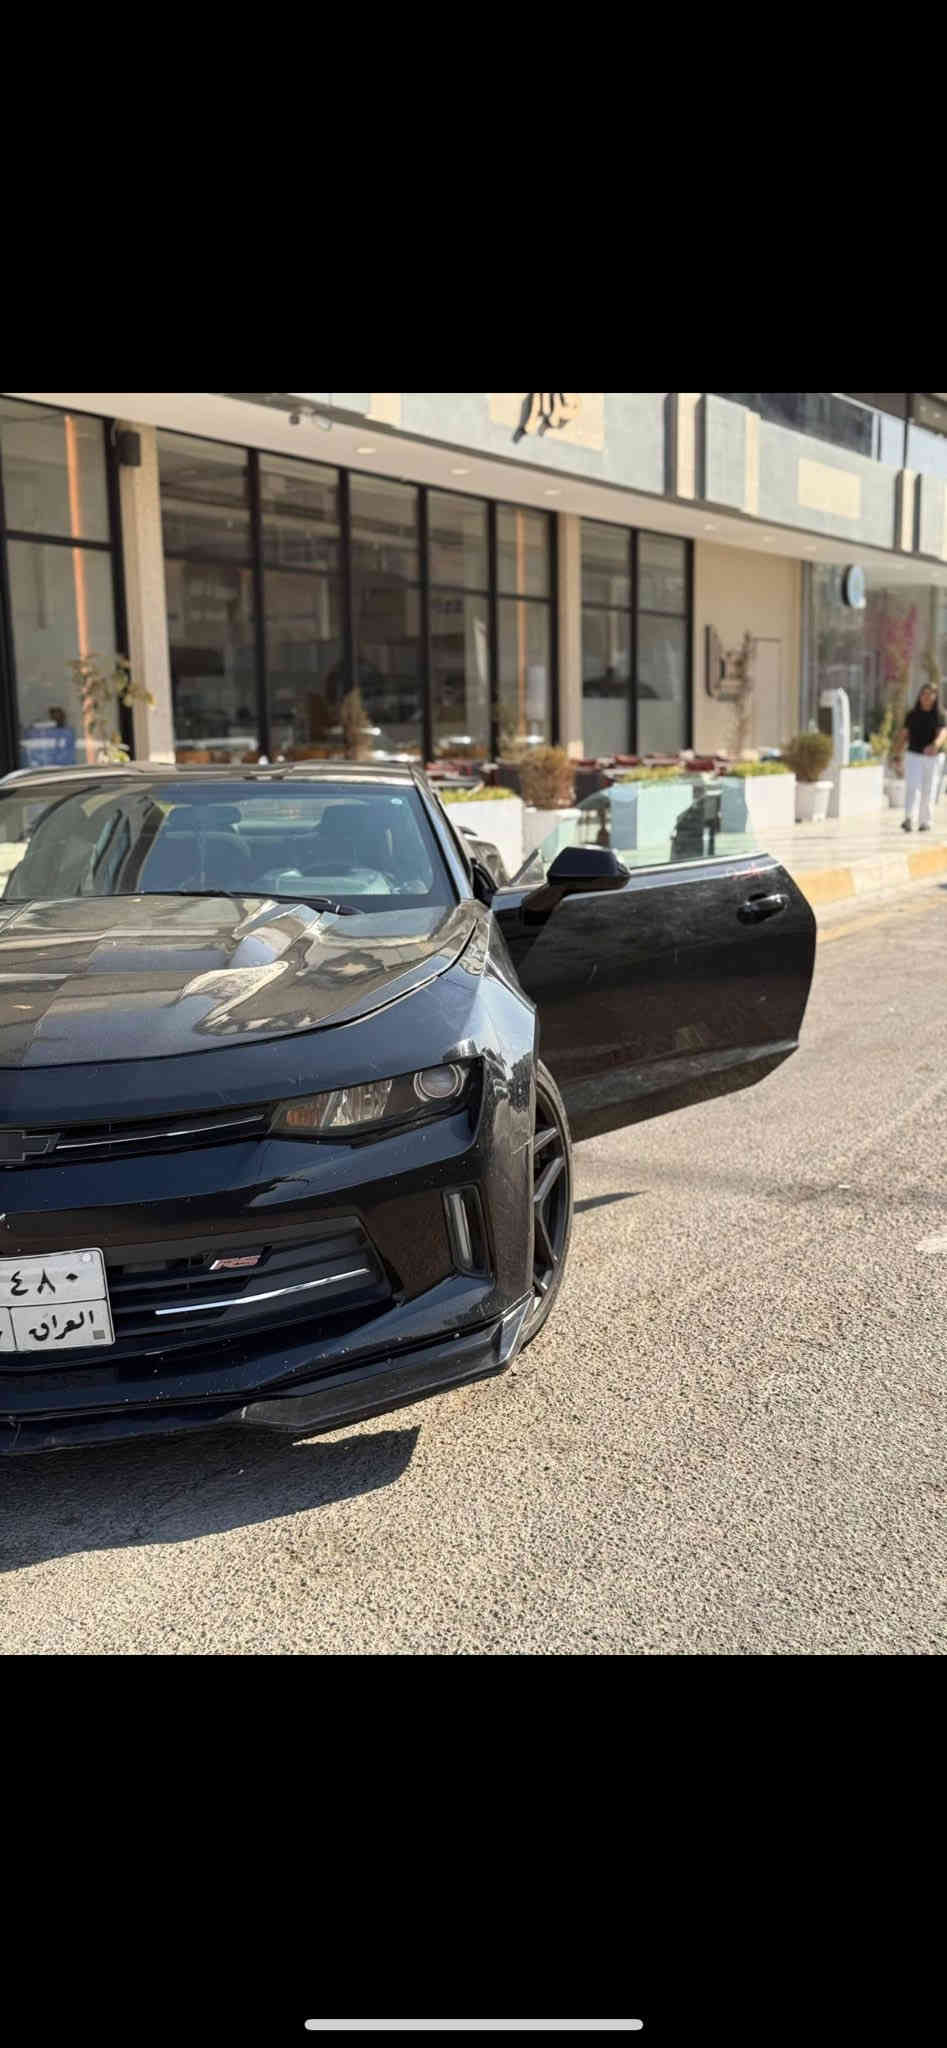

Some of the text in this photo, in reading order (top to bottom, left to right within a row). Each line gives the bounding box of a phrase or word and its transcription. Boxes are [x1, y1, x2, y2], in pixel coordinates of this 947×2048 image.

[209, 1255, 261, 1270] RS
[10, 1269, 79, 1296] ٤٨٠
[28, 1310, 94, 1341] العراق
